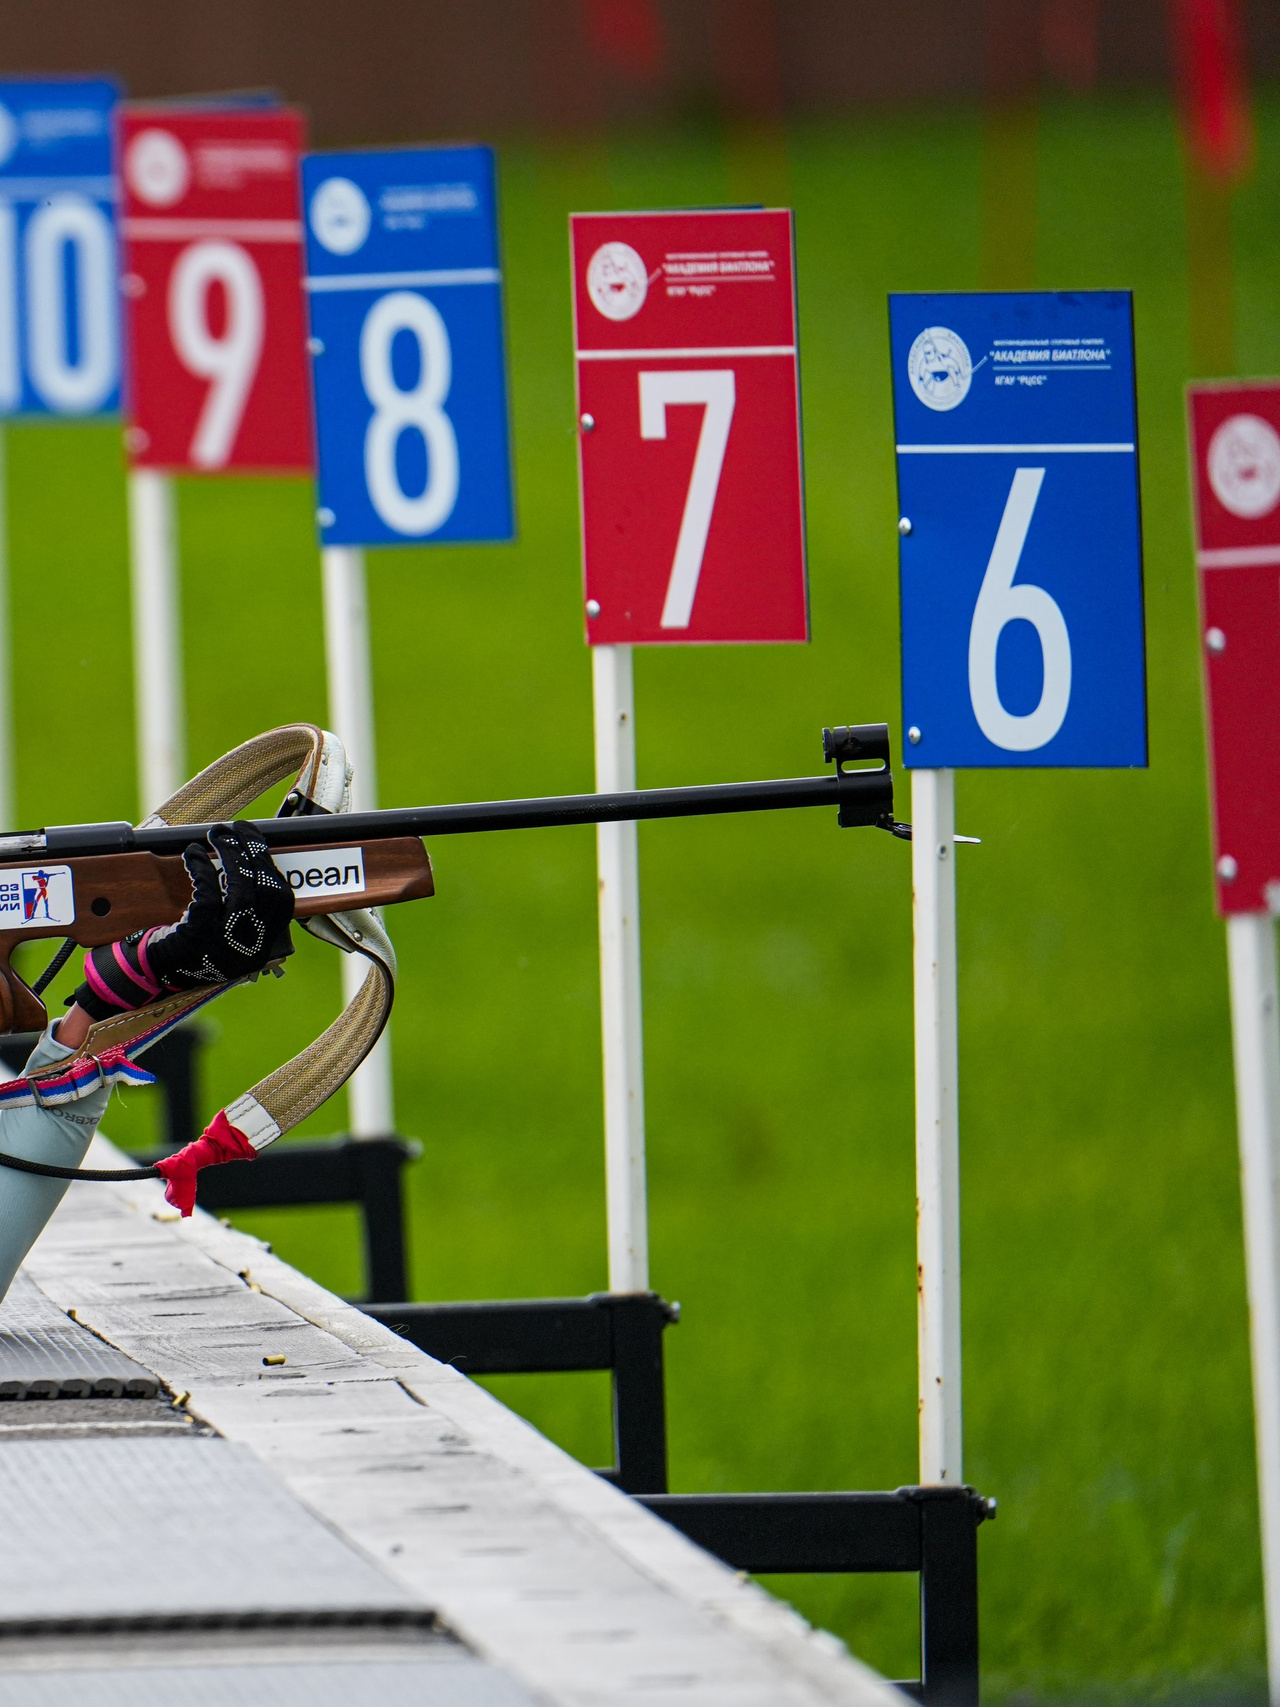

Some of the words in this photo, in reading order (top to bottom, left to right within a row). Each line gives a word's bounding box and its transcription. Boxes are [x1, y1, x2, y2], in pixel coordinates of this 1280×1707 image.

[168, 240, 265, 468] 9
[360, 291, 460, 536] 8
[989, 349, 1051, 364] "АКАДЕМИЯ
[1051, 348, 1111, 361] БИАТЛОНА"
[638, 369, 736, 629] 7
[968, 467, 1072, 752] 6
[285, 864, 360, 890] реал
[50, 1107, 101, 1126] CKBRO
